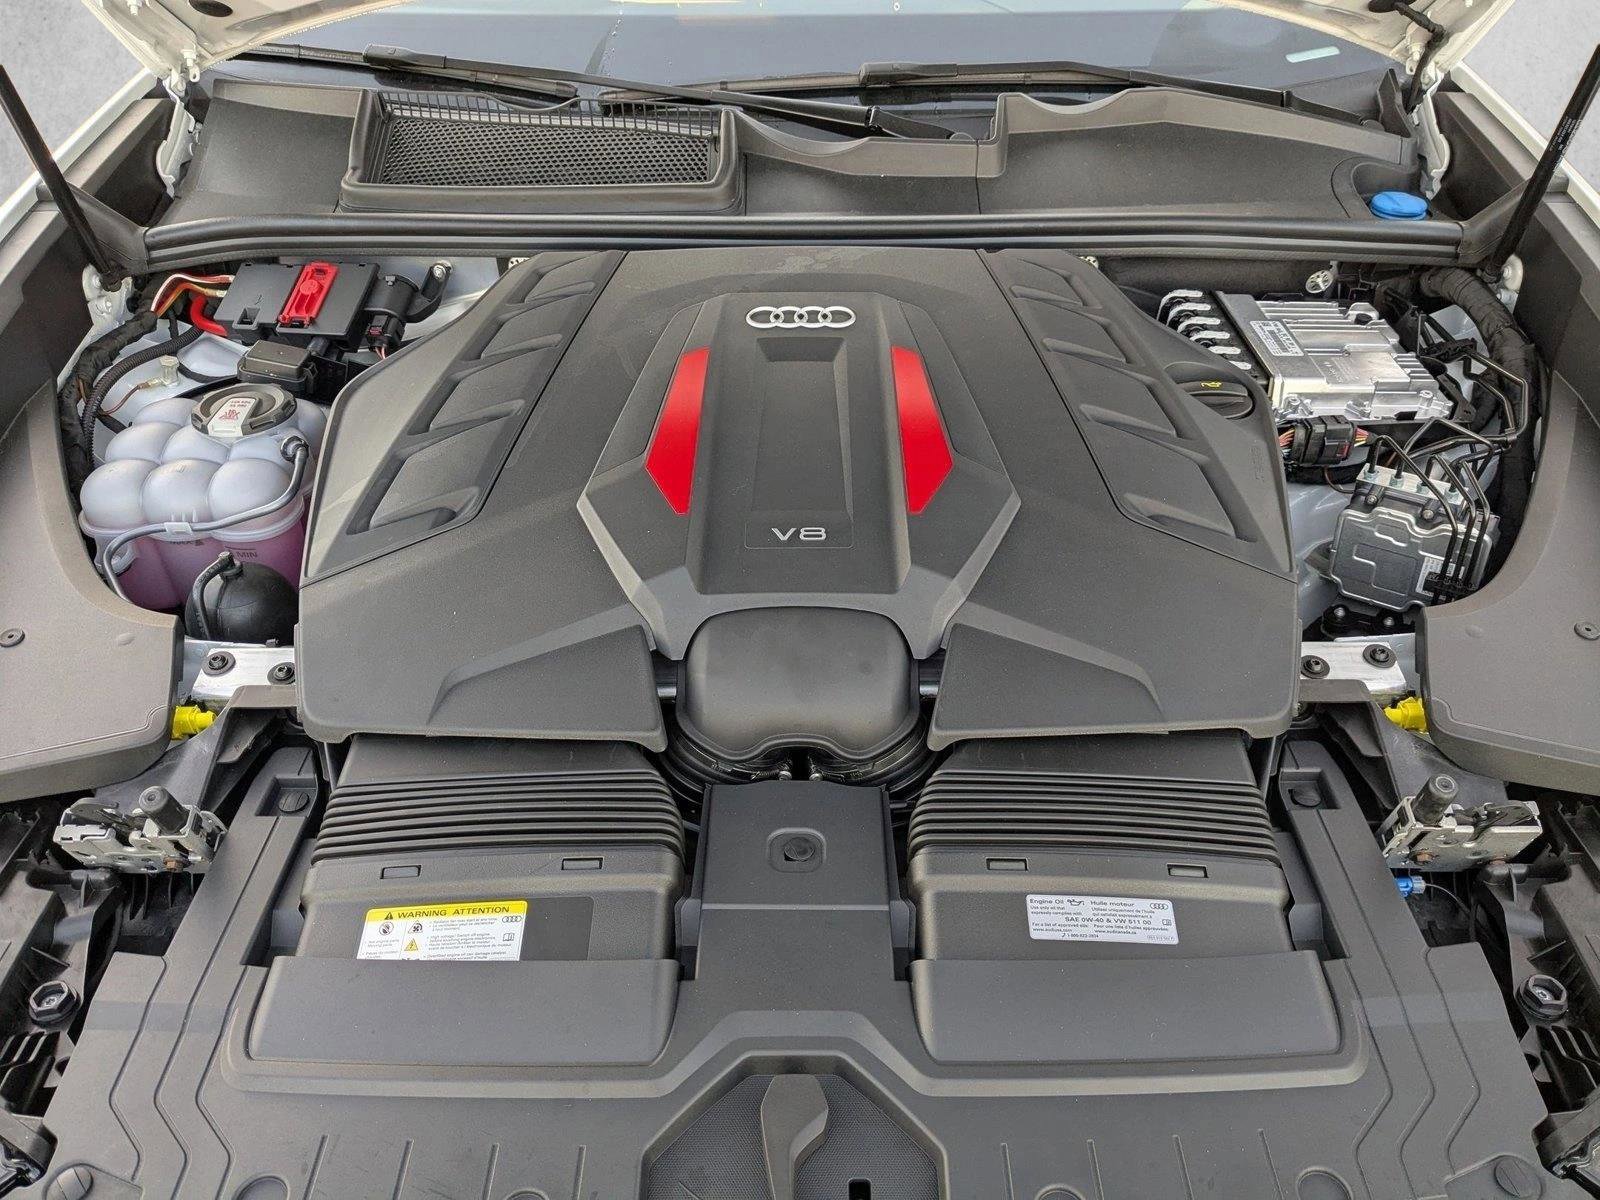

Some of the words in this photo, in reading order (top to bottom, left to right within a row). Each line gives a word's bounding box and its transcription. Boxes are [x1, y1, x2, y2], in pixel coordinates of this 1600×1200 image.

[771, 527, 827, 541] V8
[236, 551, 258, 559] MIN
[397, 910, 448, 919] WARNING
[452, 906, 510, 916] ATTENTION
